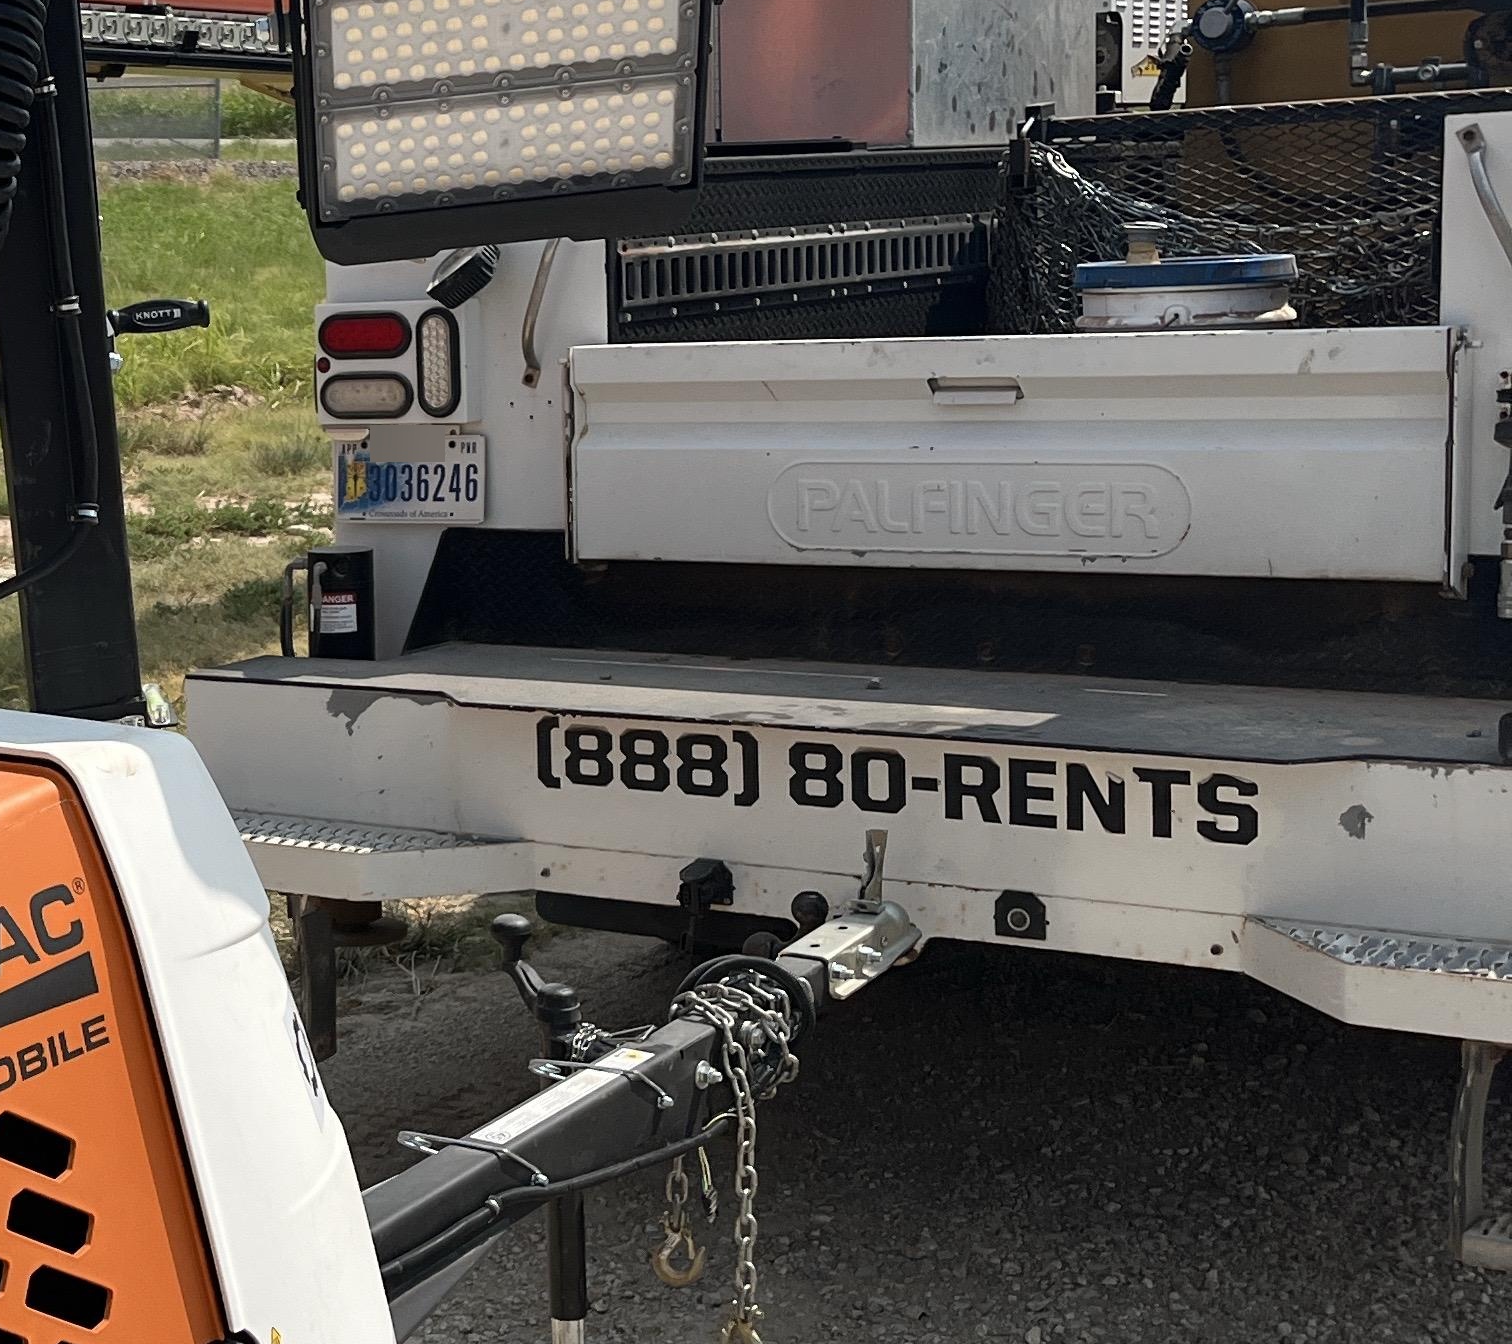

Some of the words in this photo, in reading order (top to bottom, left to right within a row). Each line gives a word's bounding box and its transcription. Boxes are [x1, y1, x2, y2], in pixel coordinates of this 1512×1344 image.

[135, 308, 174, 321] KNOTT
[794, 477, 1162, 541] PALFINGER
[535, 714, 760, 807] (888)
[788, 741, 1260, 846] 80-RENTS
